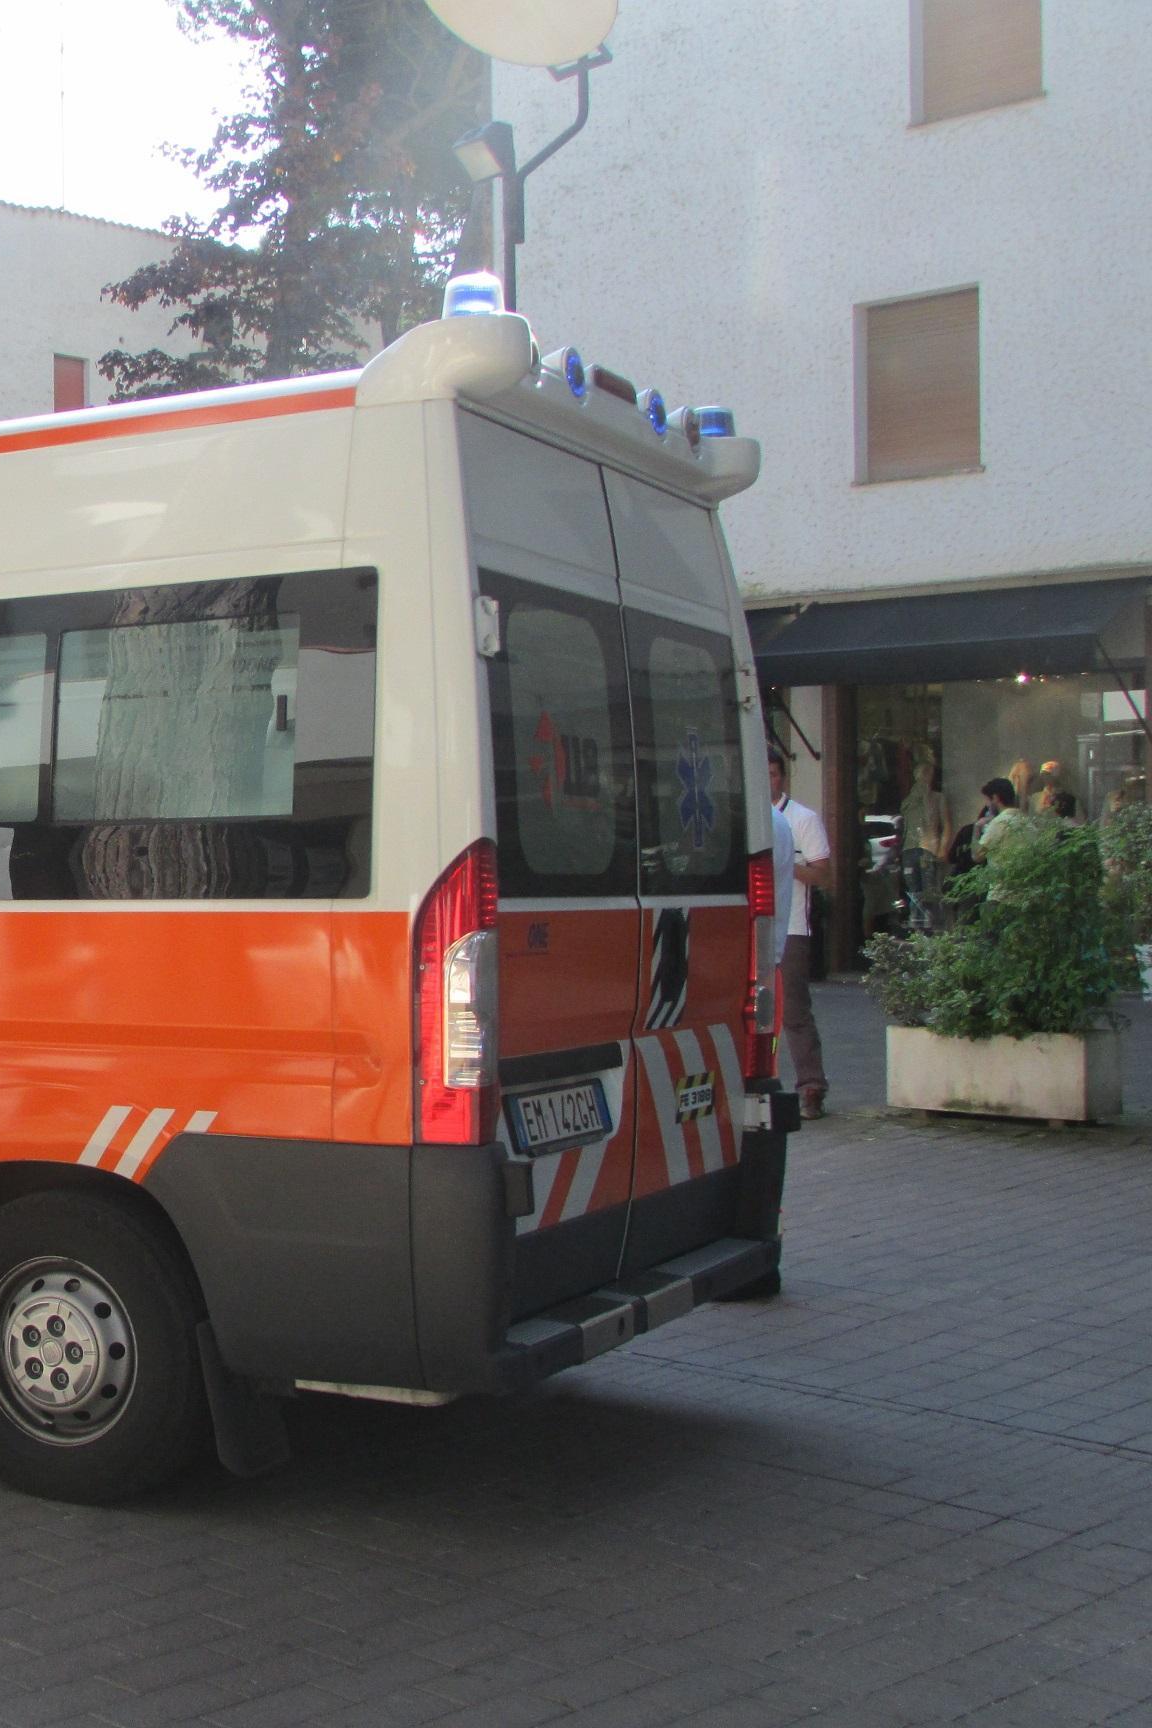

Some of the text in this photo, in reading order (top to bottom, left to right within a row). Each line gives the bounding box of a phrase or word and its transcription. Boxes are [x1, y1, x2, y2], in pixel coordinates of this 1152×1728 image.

[680, 1087, 711, 1107] FE 3188
[522, 1089, 600, 1142] EM 142GH
